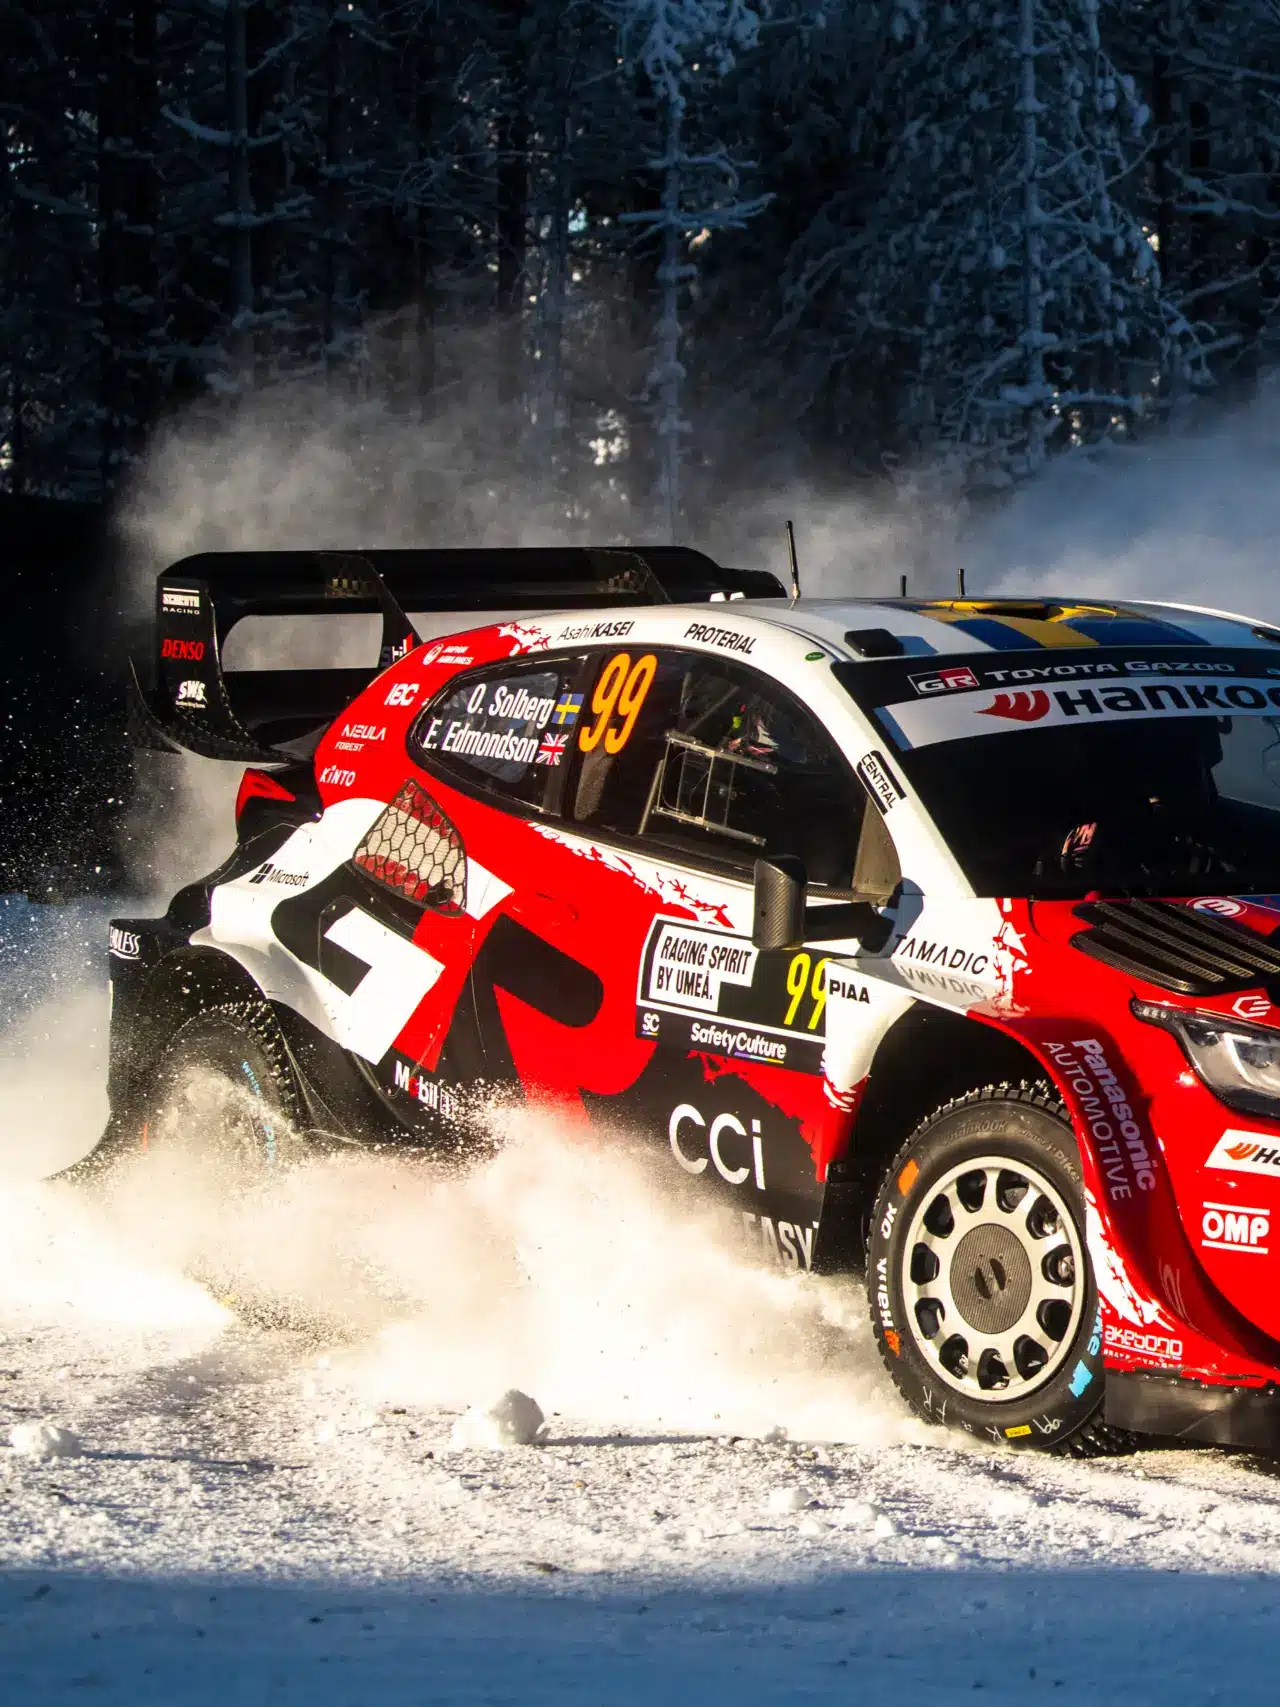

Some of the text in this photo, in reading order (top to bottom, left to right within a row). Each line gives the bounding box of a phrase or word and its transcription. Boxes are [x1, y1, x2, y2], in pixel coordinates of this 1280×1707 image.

[163, 607, 200, 615] RACING
[162, 639, 205, 660] DENSO
[684, 623, 757, 654] PROTERIAL
[178, 681, 206, 700] SWS
[918, 671, 980, 692] GR
[984, 663, 1117, 681] TOYOTA
[1124, 659, 1236, 672] GAZOO
[466, 683, 556, 729] O. Solberg
[578, 653, 658, 754] 99
[334, 741, 365, 753] FOREST
[422, 719, 540, 763] E. Edmondson
[861, 754, 897, 809] CENTRAL
[266, 868, 310, 887] Microsoft
[660, 935, 752, 975] RACING SPIRIT
[892, 934, 988, 975] TAMADIC
[656, 966, 674, 994] BY
[783, 953, 832, 1030] 99
[829, 979, 870, 1004] PIAA
[642, 1012, 660, 1032] SC
[690, 1022, 788, 1059] SafetyCulture
[394, 1060, 438, 1110] Mobil
[1041, 1042, 1132, 1200] AUTOMOTIVE
[1071, 1038, 1159, 1191] Panasonic
[1202, 1210, 1270, 1245] OMP
[1104, 1325, 1183, 1357] akebono
